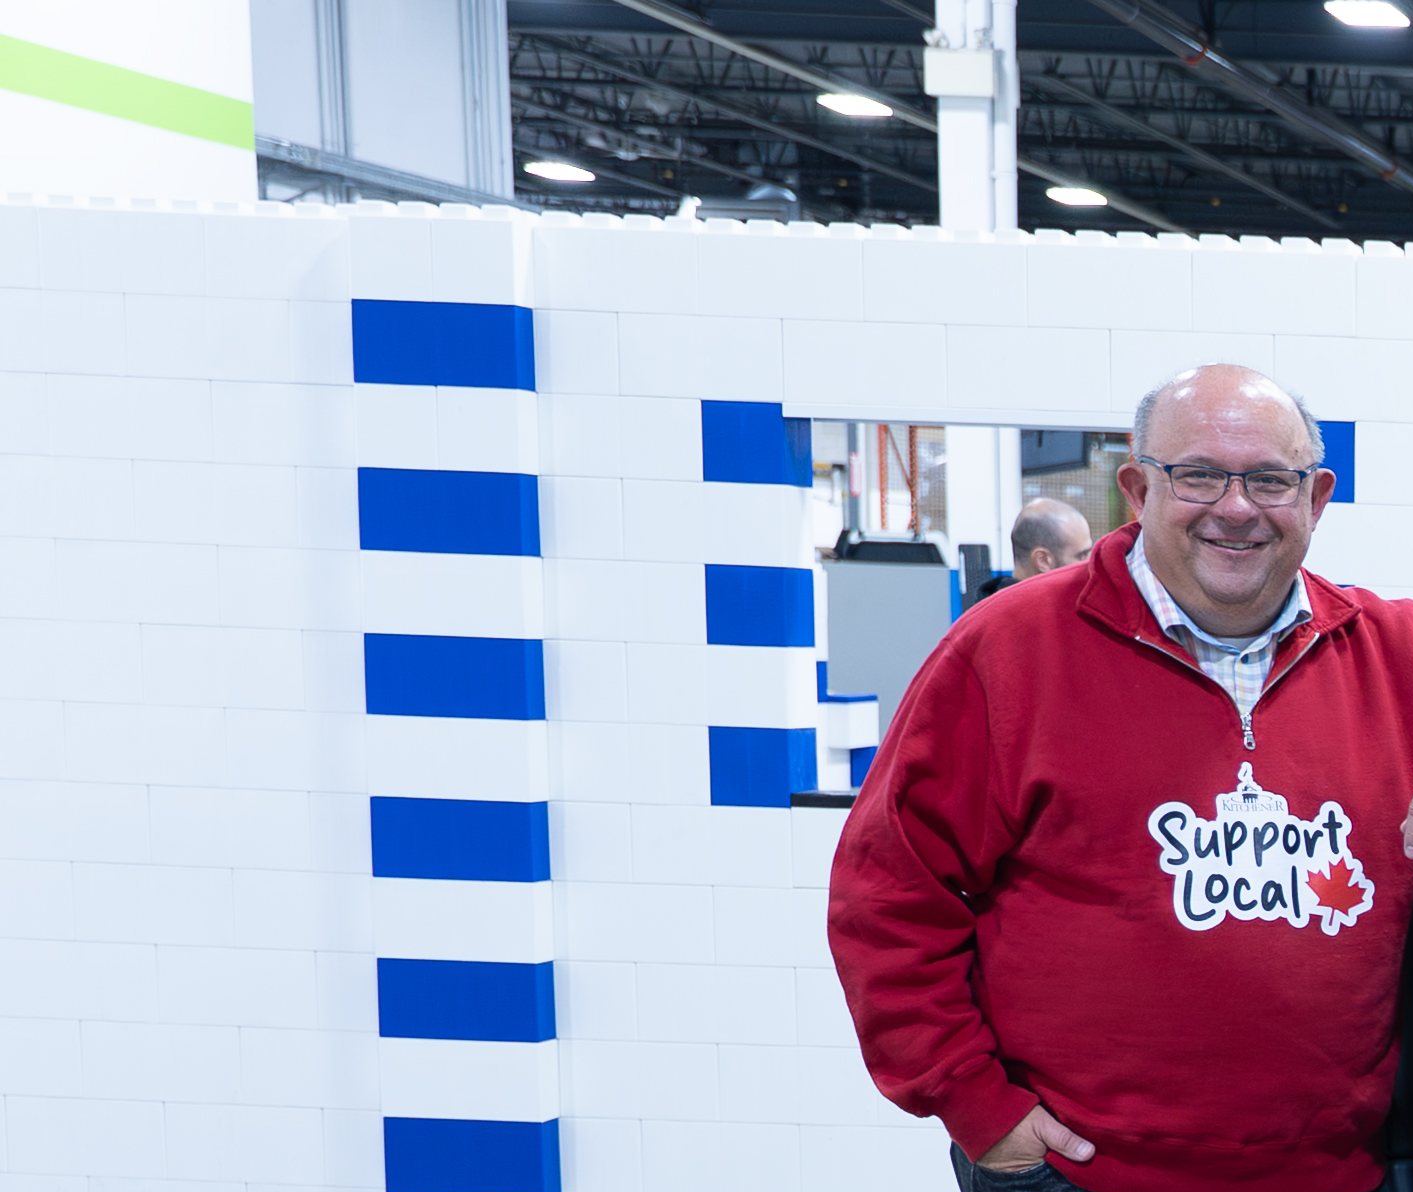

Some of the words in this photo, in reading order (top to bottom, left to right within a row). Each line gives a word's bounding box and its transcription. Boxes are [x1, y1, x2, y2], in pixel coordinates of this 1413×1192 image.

[1222, 799, 1285, 812] KITCHENER
[1157, 810, 1343, 867] Support
[1183, 865, 1301, 922] Local
